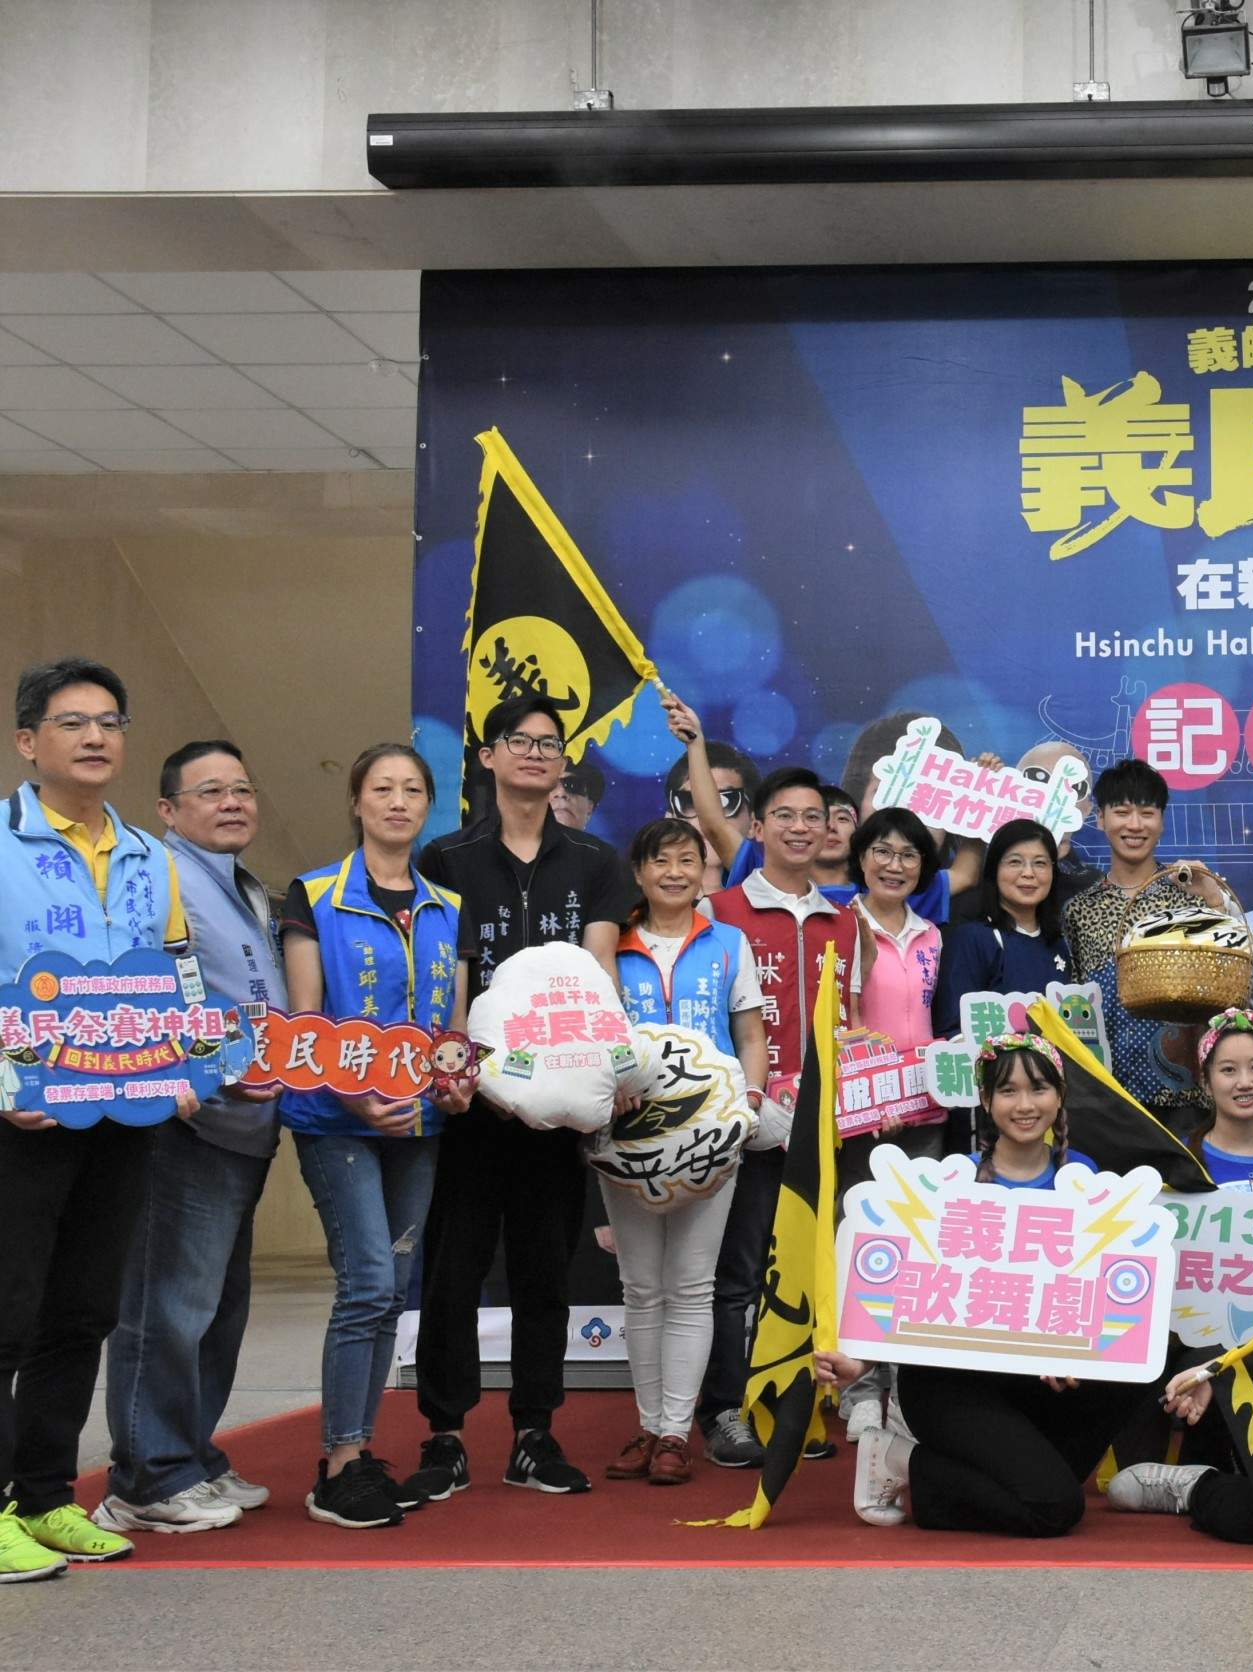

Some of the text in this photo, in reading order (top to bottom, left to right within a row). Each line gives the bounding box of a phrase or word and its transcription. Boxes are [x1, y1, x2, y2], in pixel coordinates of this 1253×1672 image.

[1075, 628, 1194, 658] Hsinchu
[920, 754, 1046, 809] Hakka
[498, 905, 511, 936] 秘書
[61, 977, 175, 994] 新竹縣政府稅務局
[548, 976, 581, 988] 2022
[638, 982, 657, 1014] 助理
[0, 1005, 225, 1045] 義民祭賽神組
[503, 1010, 632, 1051] 義民祭
[970, 1001, 1006, 1045] 我
[64, 1046, 174, 1071] 回到義民時代
[935, 1052, 974, 1097] 新
[590, 1121, 741, 1197] 平安
[937, 1198, 1074, 1268] 義民
[892, 1260, 1108, 1338] 歌舞劇
